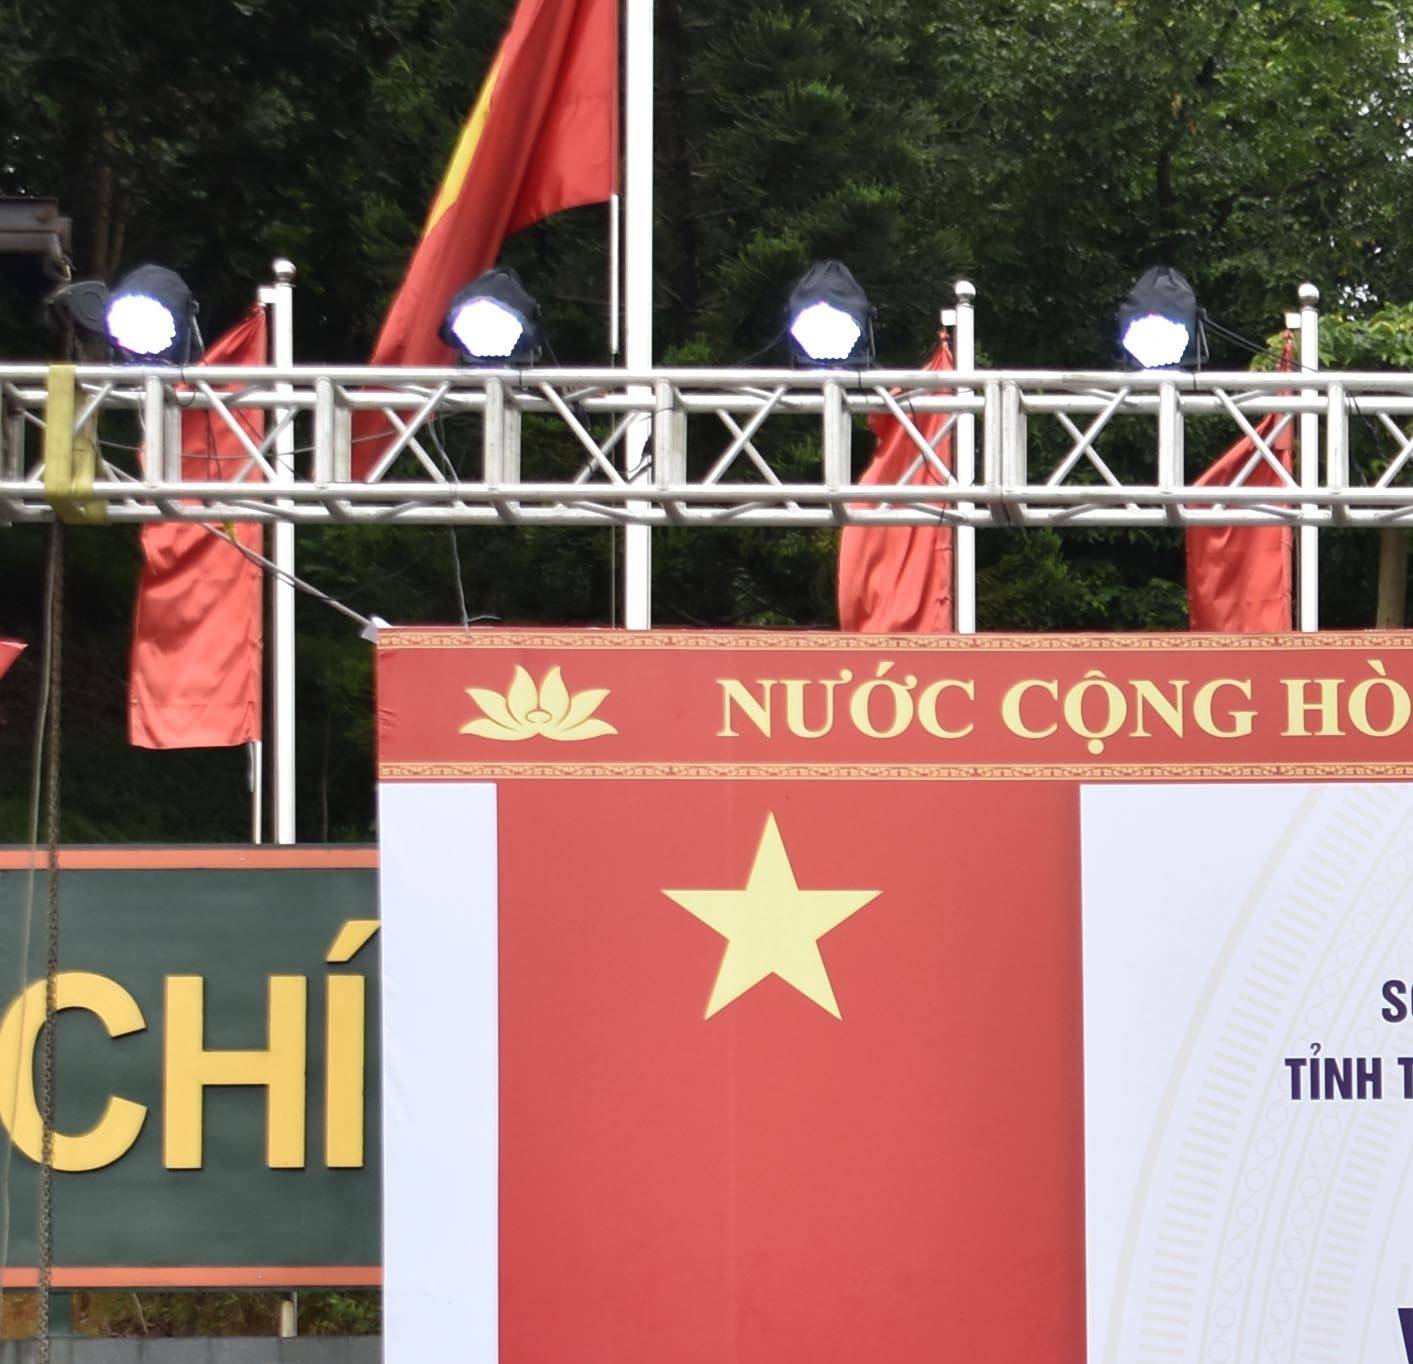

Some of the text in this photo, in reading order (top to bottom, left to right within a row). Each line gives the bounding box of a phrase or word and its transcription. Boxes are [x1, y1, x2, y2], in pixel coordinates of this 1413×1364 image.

[716, 661, 975, 739] NƯỚC
[1001, 669, 1258, 755] CỘNG
[0, 920, 381, 1172] CHÍ
[1285, 1042, 1382, 1101] TỈNH
